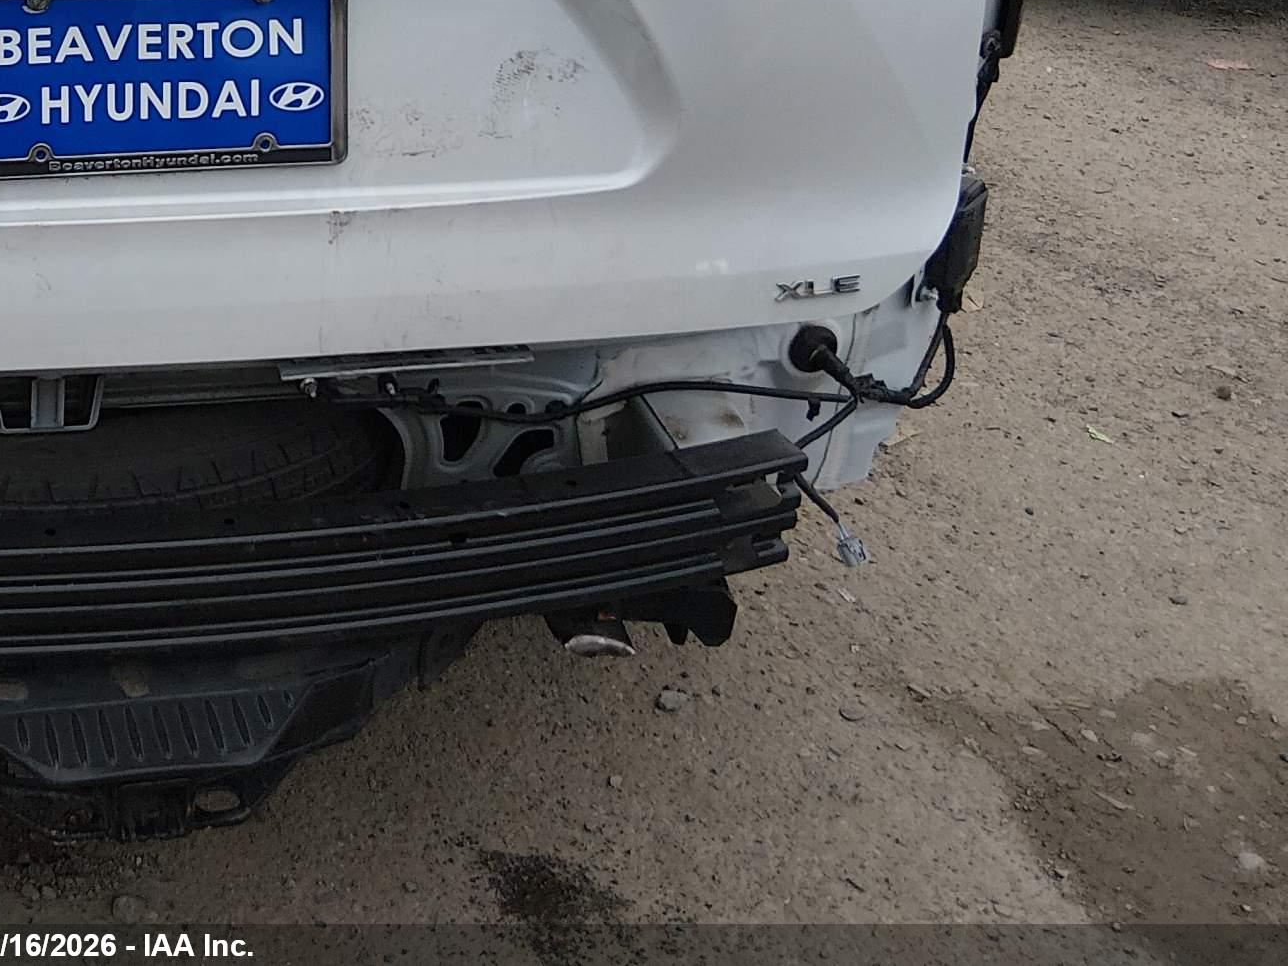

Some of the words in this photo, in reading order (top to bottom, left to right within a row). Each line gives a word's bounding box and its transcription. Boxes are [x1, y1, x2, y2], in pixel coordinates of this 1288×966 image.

[40, 79, 260, 125] HYUNDAI
[48, 153, 259, 172] BeavertonHyundai.com
[774, 274, 861, 302] XLE
